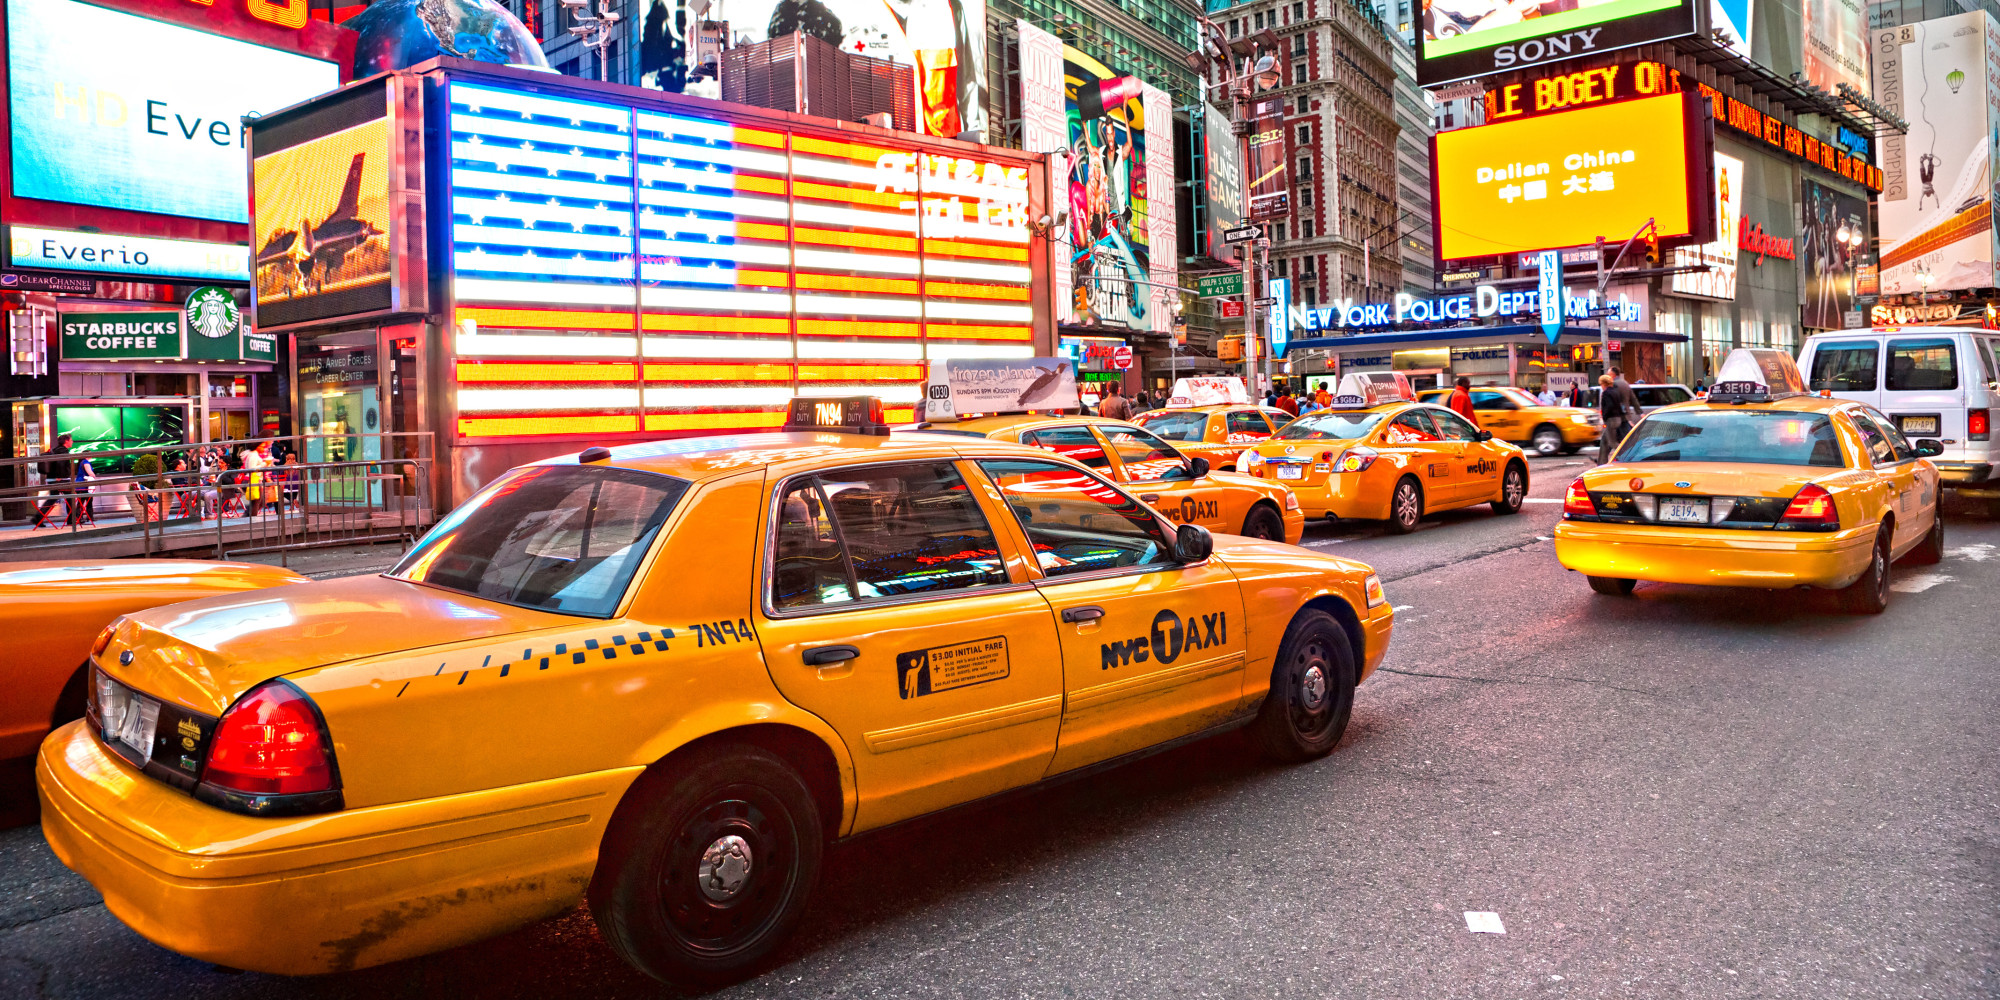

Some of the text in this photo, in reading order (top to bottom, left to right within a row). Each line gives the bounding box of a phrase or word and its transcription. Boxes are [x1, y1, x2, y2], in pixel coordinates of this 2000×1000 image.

[1880, 32, 1896, 53] GO
[1901, 28, 1910, 41] 8
[1494, 27, 1602, 67] SONY
[1819, 41, 1831, 56] dress
[1021, 42, 1064, 93] VIVA
[1436, 86, 1480, 101] SHERWOOD
[1535, 65, 1618, 110] BOGEY
[1634, 61, 1666, 94] ON
[54, 81, 246, 149] HD Ever
[1250, 129, 1283, 145] CSI:
[1728, 96, 1762, 138] DONOVAN
[1763, 114, 1782, 147] MEET
[1784, 125, 1803, 157] AGAIN
[1804, 134, 1820, 164] WITH
[1820, 142, 1837, 172] FINAL
[1837, 150, 1852, 179] FOUR
[1852, 157, 1865, 184] SPOT
[1866, 164, 1875, 189] ON
[1222, 144, 1232, 161] THE
[1207, 148, 1240, 189] HUNGE
[1477, 150, 1635, 184] Dalian China
[1208, 174, 1241, 217] GAME
[1230, 232, 1241, 240] ONE
[1738, 214, 1796, 266] Walgreens
[42, 239, 149, 265] Everio
[1200, 278, 1216, 287] ADOLPH
[1223, 276, 1234, 284] OCHS
[1442, 270, 1480, 282] SHERWOOD
[1207, 285, 1235, 295] W 43 ST
[1544, 254, 1555, 322] NYPD
[1100, 292, 1128, 322] GLAM
[1871, 304, 1962, 322] Subway
[65, 322, 177, 336] STARBUCKS
[85, 336, 157, 349] COFFEE
[249, 338, 271, 353] COFFEE
[310, 354, 372, 370] U.S. ARMED FORCES
[1350, 356, 1382, 366] POLICE
[1462, 350, 1498, 361] POLICE
[315, 369, 364, 384] CAREER CENTER
[952, 365, 1037, 384] frozen planet
[931, 385, 948, 399] 1D30
[1374, 382, 1398, 390] TOPMAN
[1724, 383, 1751, 393] 3E19
[798, 402, 808, 411] OFF
[815, 402, 843, 425] 7N94
[849, 402, 860, 410] OFF
[796, 413, 810, 422] DUTY
[848, 413, 862, 422] DUTY
[1467, 457, 1497, 475] NYC TAXI
[1180, 496, 1218, 523] TAXI
[688, 618, 754, 648] 7N94
[1101, 609, 1227, 671] NYC TAXI
[931, 641, 1003, 662] $3.00 INITIAL FARE
